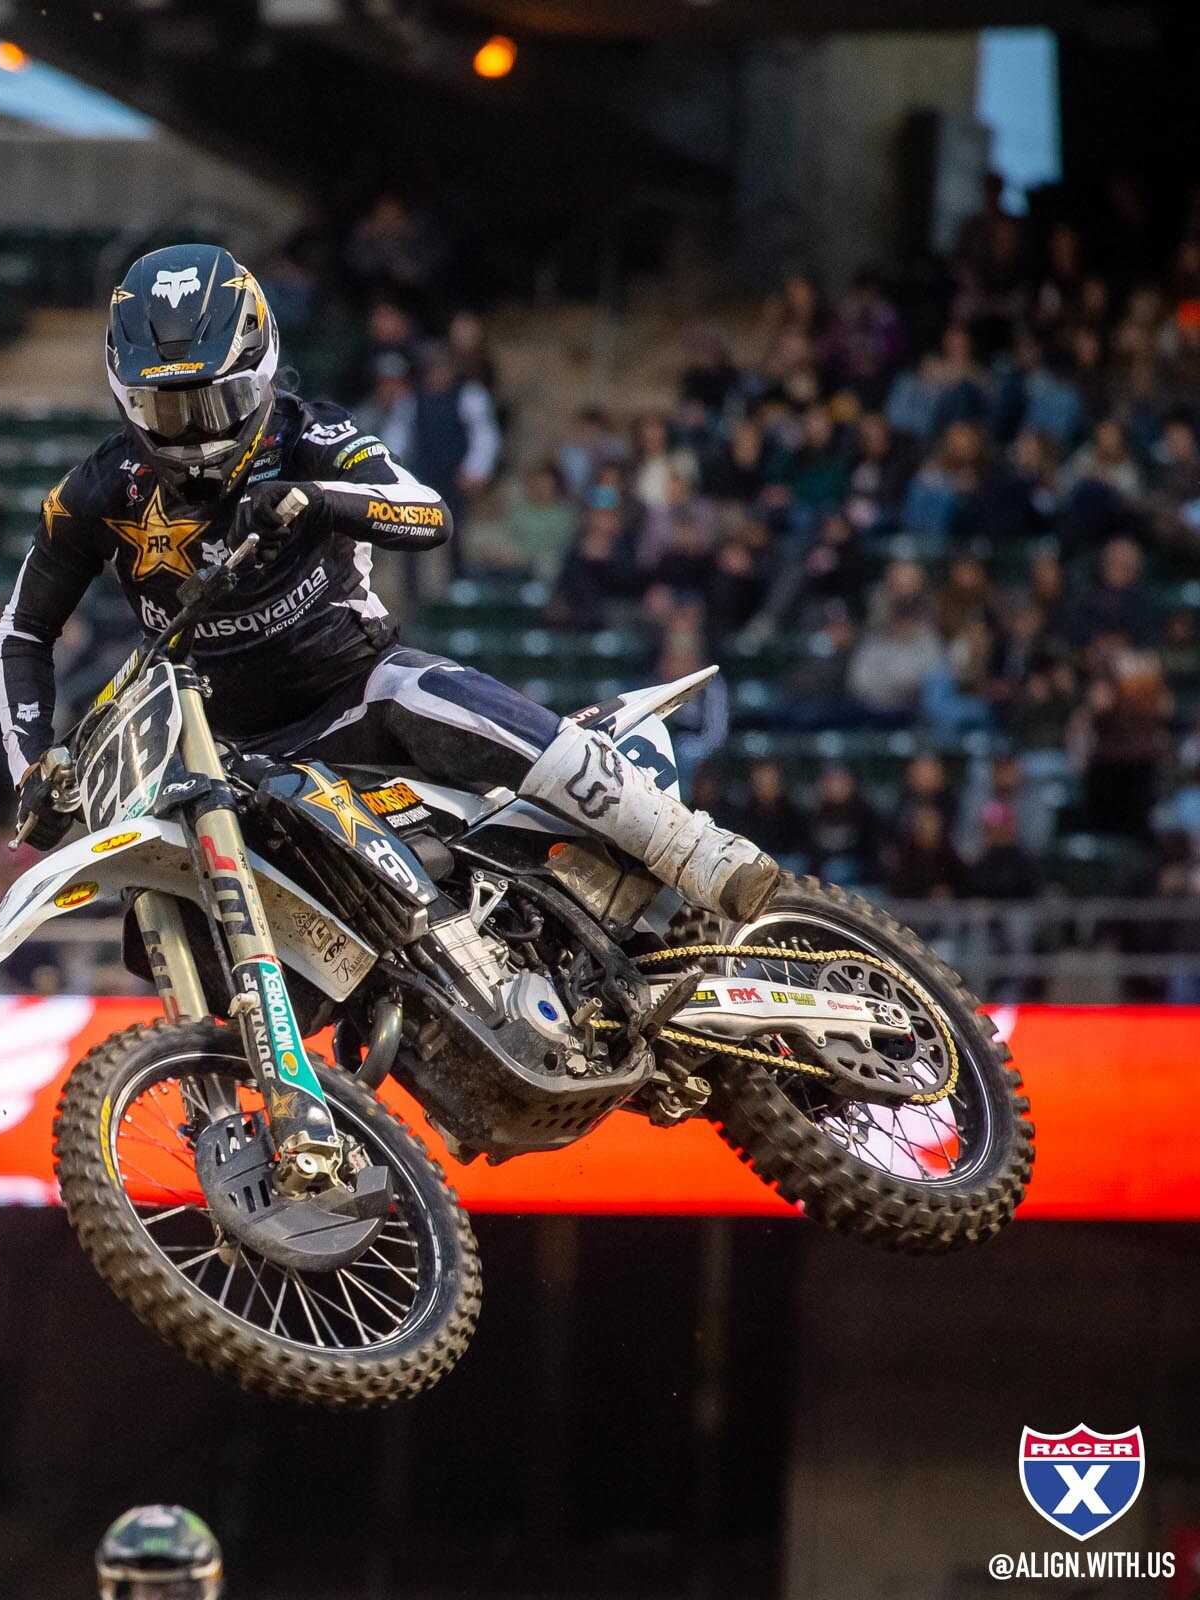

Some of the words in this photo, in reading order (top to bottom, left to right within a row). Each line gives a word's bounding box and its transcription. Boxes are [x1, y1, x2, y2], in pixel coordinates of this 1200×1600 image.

[140, 362, 205, 376] ROCKSTAR
[367, 501, 443, 526] ROCKSTAR
[372, 521, 410, 536] ENERGY
[410, 526, 436, 537] DRINK
[194, 566, 327, 639] usqvarna
[264, 606, 305, 637] FACTORY
[360, 783, 422, 816] ROCKSTAR
[54, 881, 99, 908] FMF
[727, 987, 761, 1002] RK
[262, 967, 295, 1052] MOTOREX
